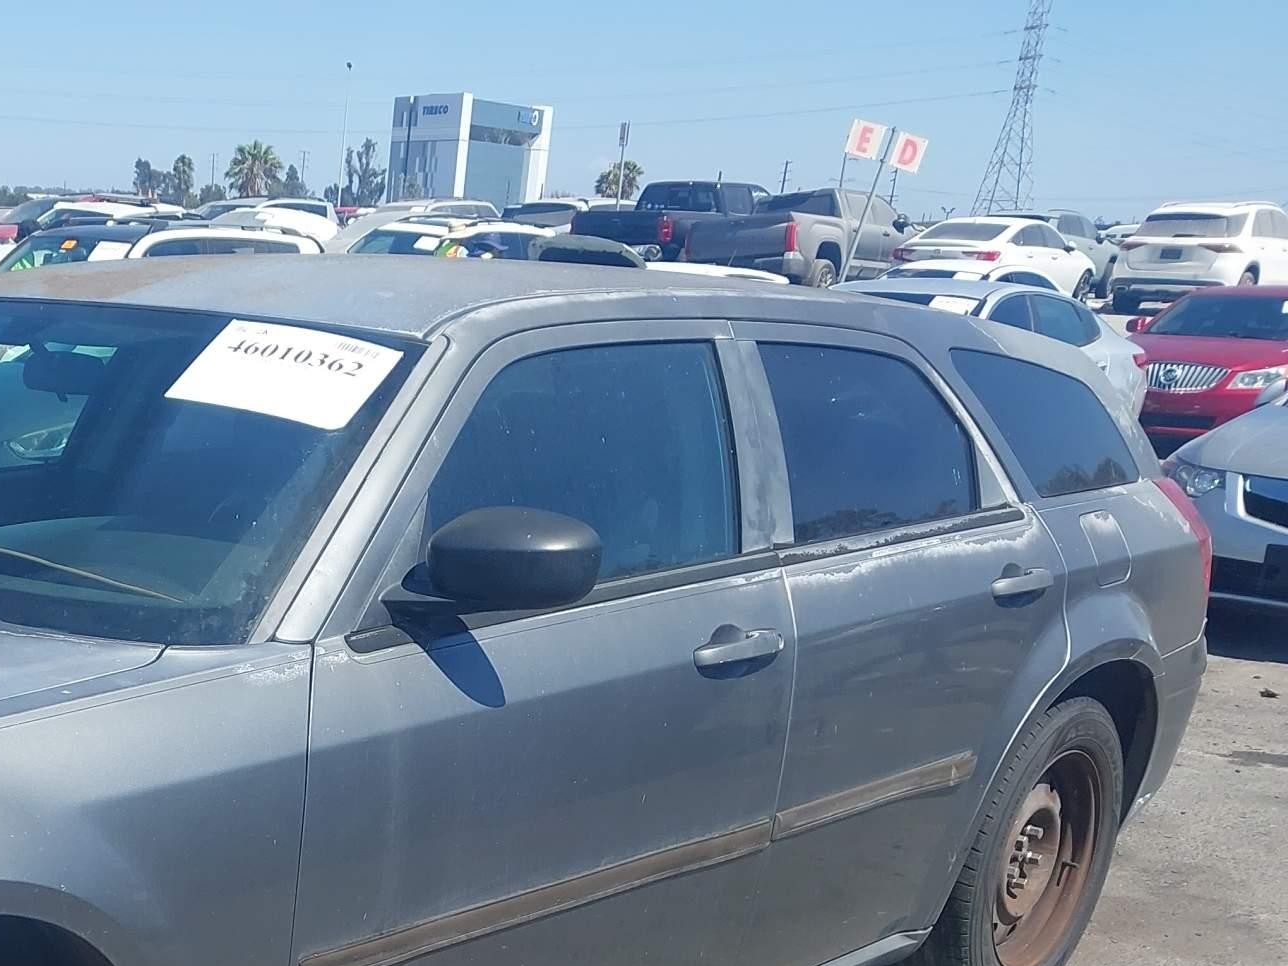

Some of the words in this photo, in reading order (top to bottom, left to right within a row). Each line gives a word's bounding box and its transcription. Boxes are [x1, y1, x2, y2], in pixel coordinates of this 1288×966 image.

[855, 126, 874, 153] E
[897, 138, 918, 166] D
[228, 339, 364, 376] 46010362
